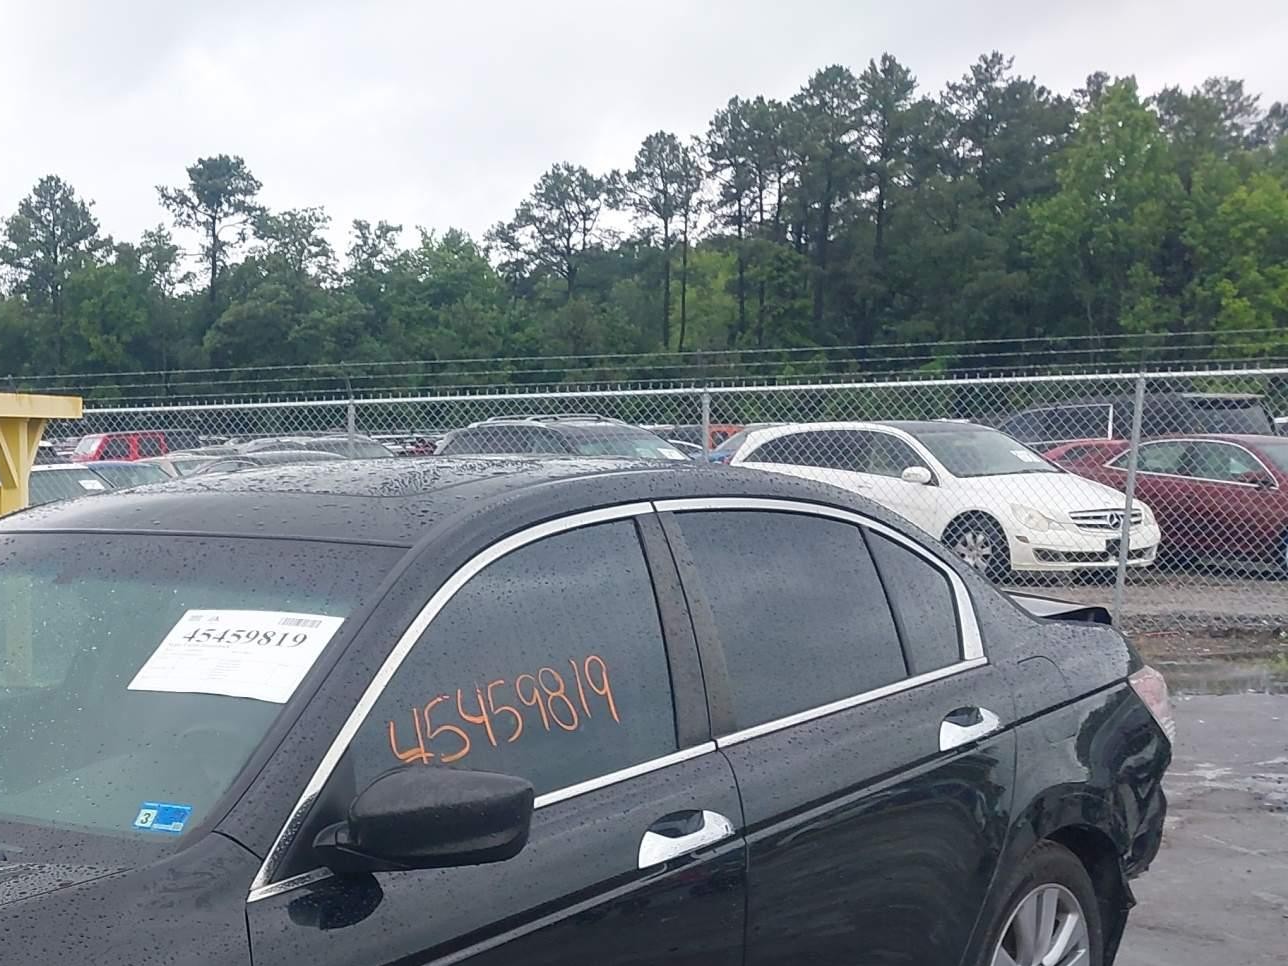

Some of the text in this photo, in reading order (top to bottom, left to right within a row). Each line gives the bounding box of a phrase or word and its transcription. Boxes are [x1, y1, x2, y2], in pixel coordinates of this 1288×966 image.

[183, 627, 308, 648] 45459819
[389, 655, 620, 765] 45459819
[140, 812, 152, 825] 3
